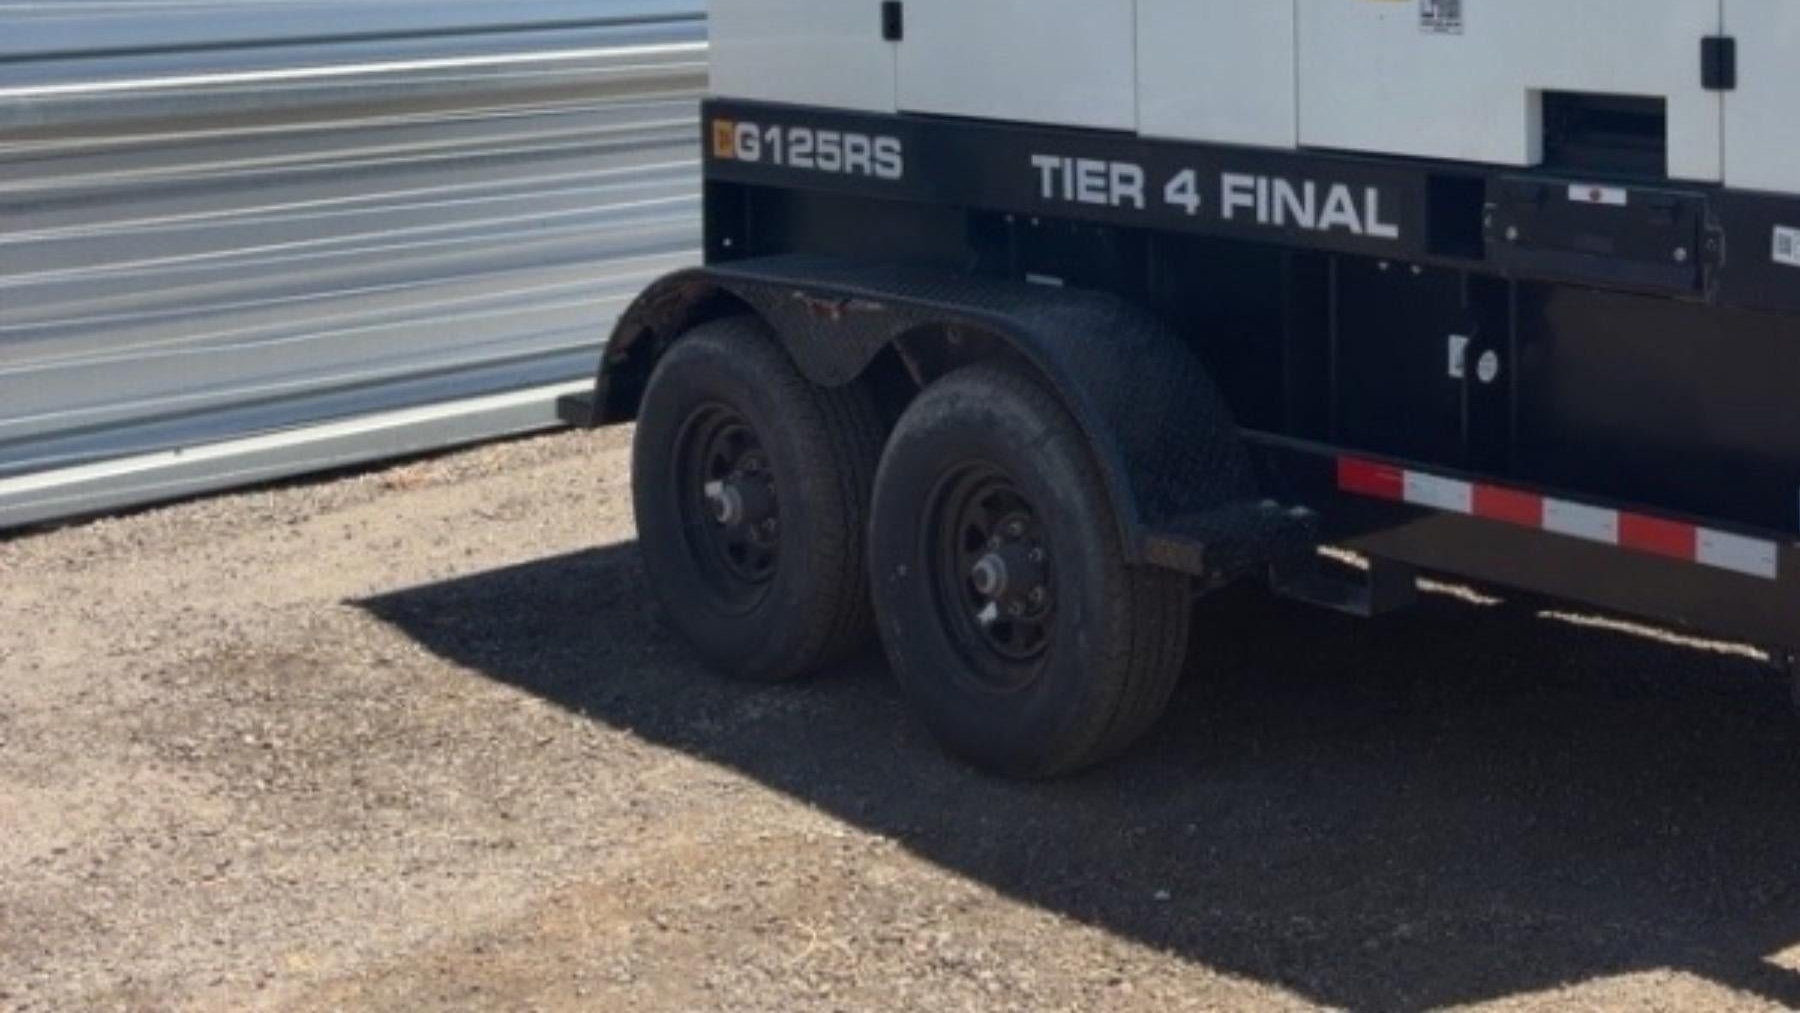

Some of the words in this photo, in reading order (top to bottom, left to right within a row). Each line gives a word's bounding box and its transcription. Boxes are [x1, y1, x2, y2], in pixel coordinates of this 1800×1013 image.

[734, 121, 903, 179] G125RS
[1031, 155, 1144, 208] TIER
[1163, 169, 1201, 214] 4
[1221, 174, 1398, 238] FINAL
